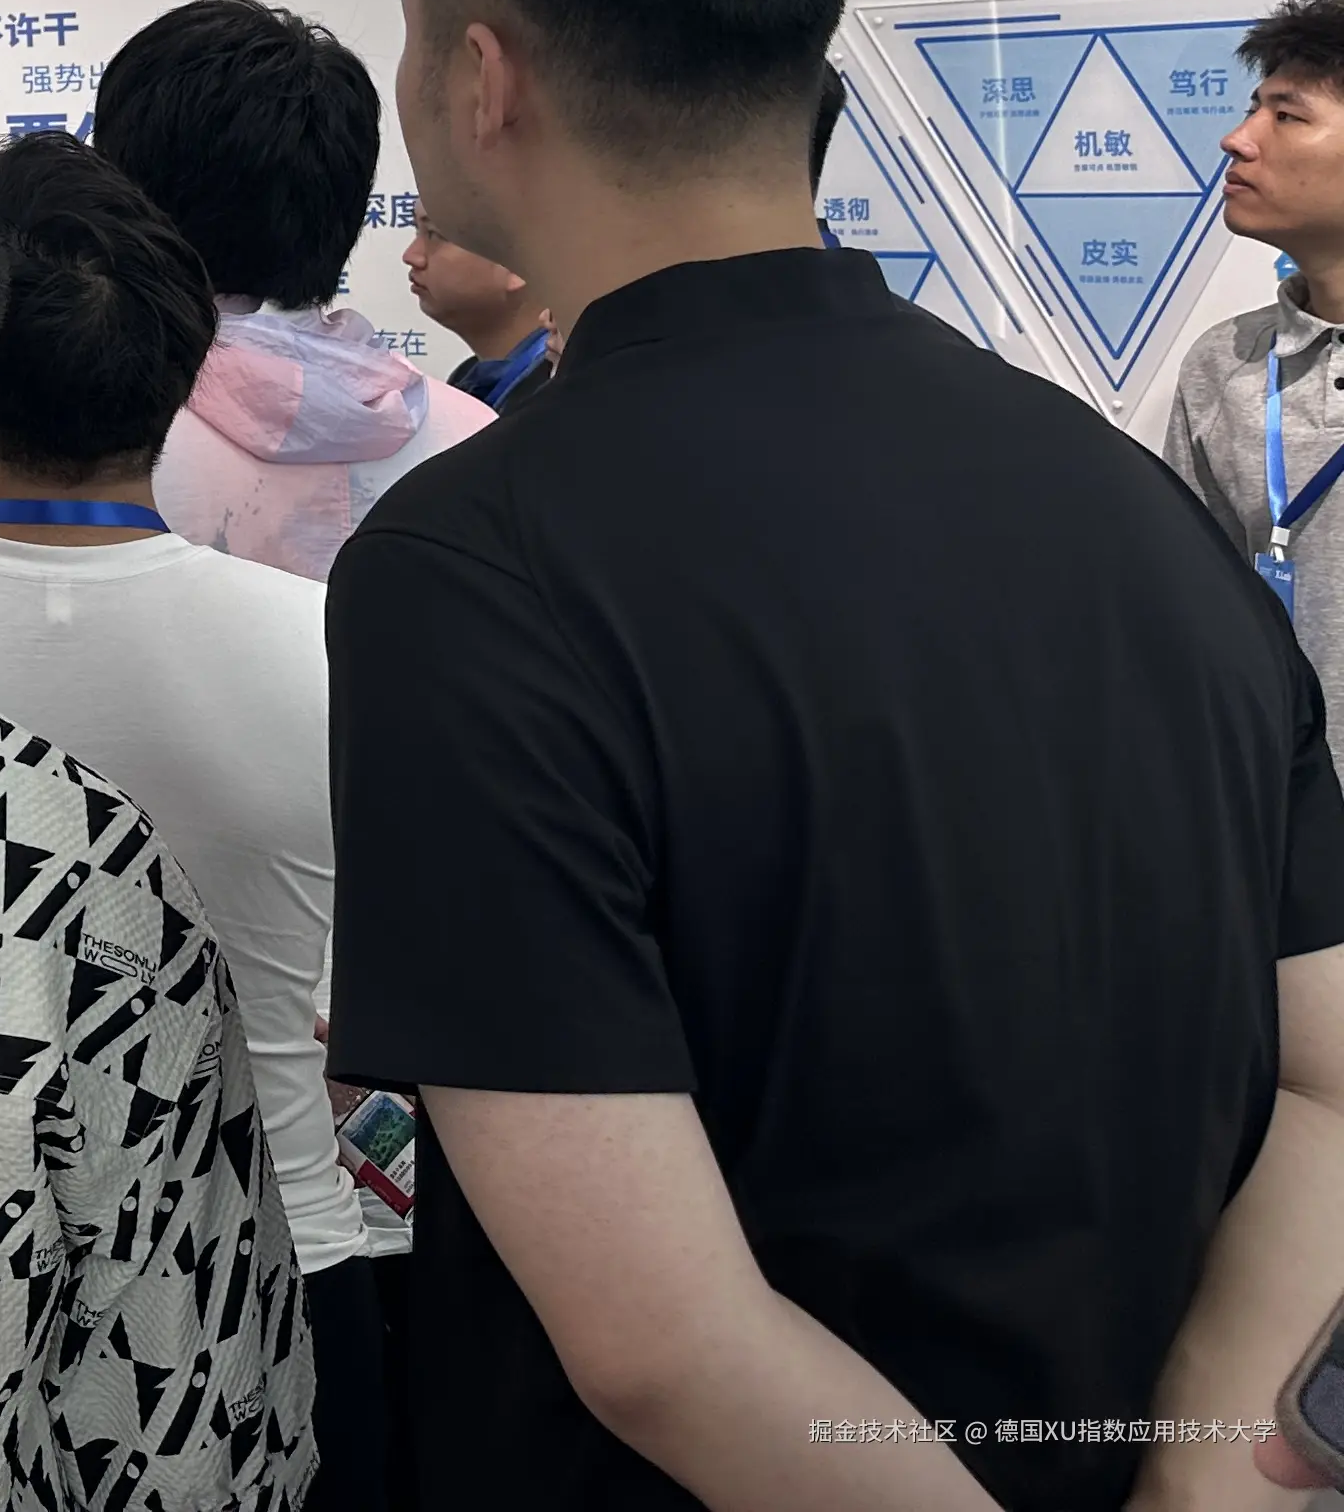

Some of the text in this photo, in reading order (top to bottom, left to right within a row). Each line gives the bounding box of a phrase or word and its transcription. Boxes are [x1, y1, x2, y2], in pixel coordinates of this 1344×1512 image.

[981, 76, 1037, 104] 深思
[1168, 68, 1229, 98] 笃行
[1074, 129, 1134, 157] 机敏
[823, 198, 870, 222] 透彻
[1081, 239, 1139, 267] 皮实
[82, 932, 157, 973] THESONLI
